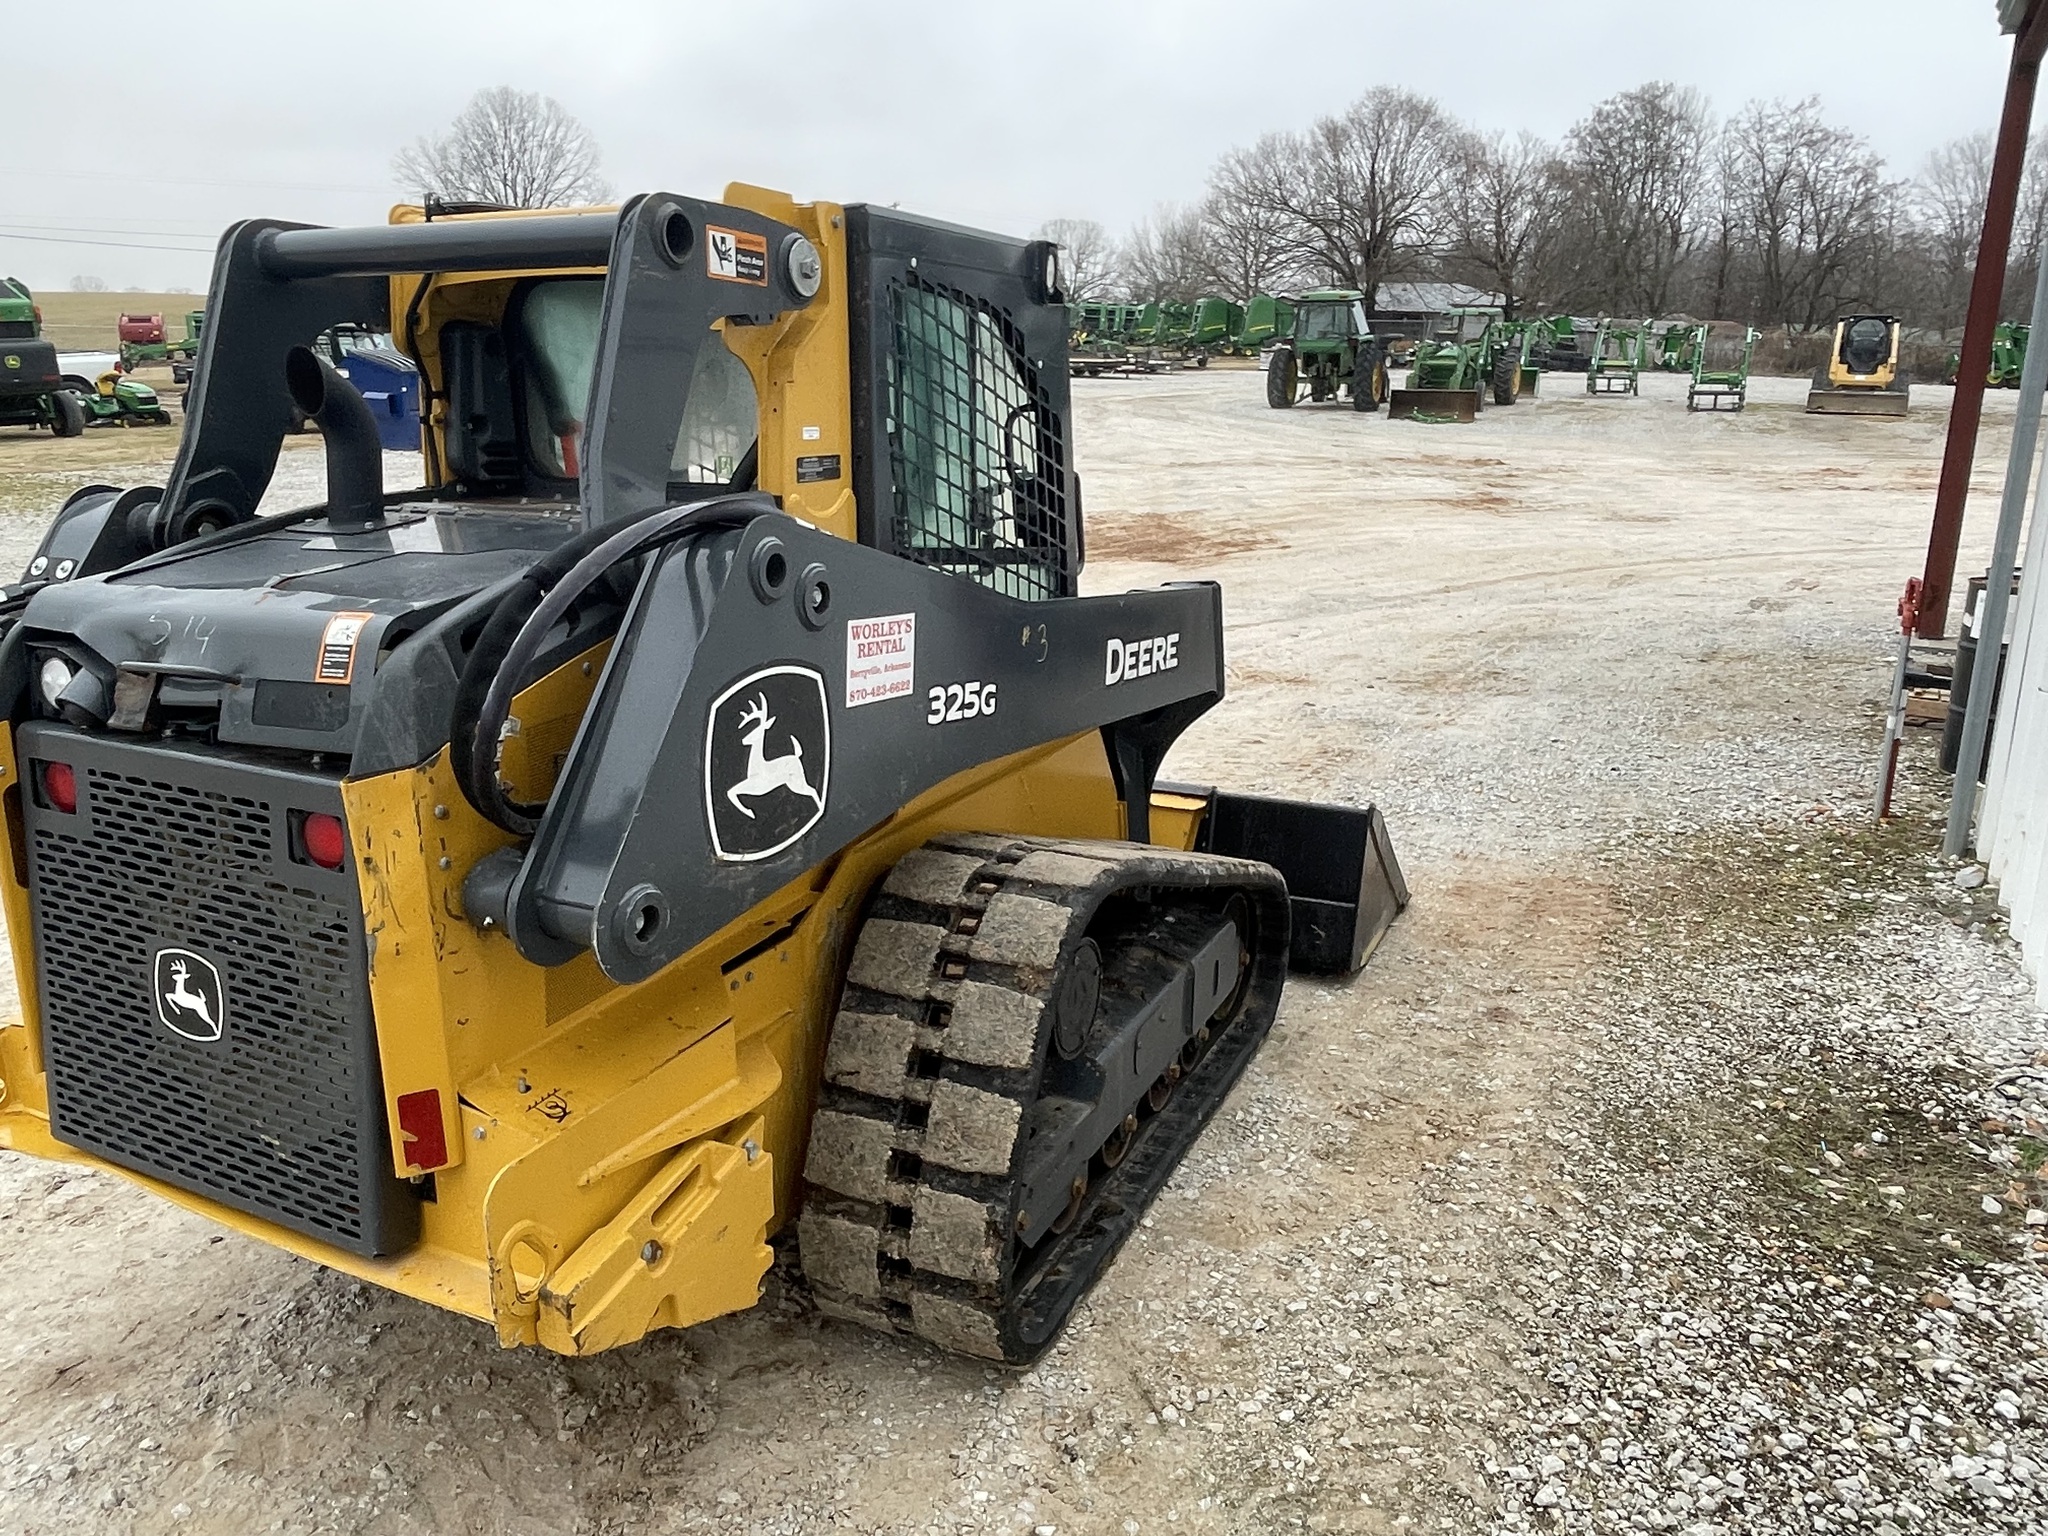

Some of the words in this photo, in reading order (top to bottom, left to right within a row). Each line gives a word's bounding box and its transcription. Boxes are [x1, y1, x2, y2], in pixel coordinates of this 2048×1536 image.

[857, 638, 906, 659] RENTAL
[1105, 633, 1180, 686] DEERE
[927, 681, 997, 725] 325G
